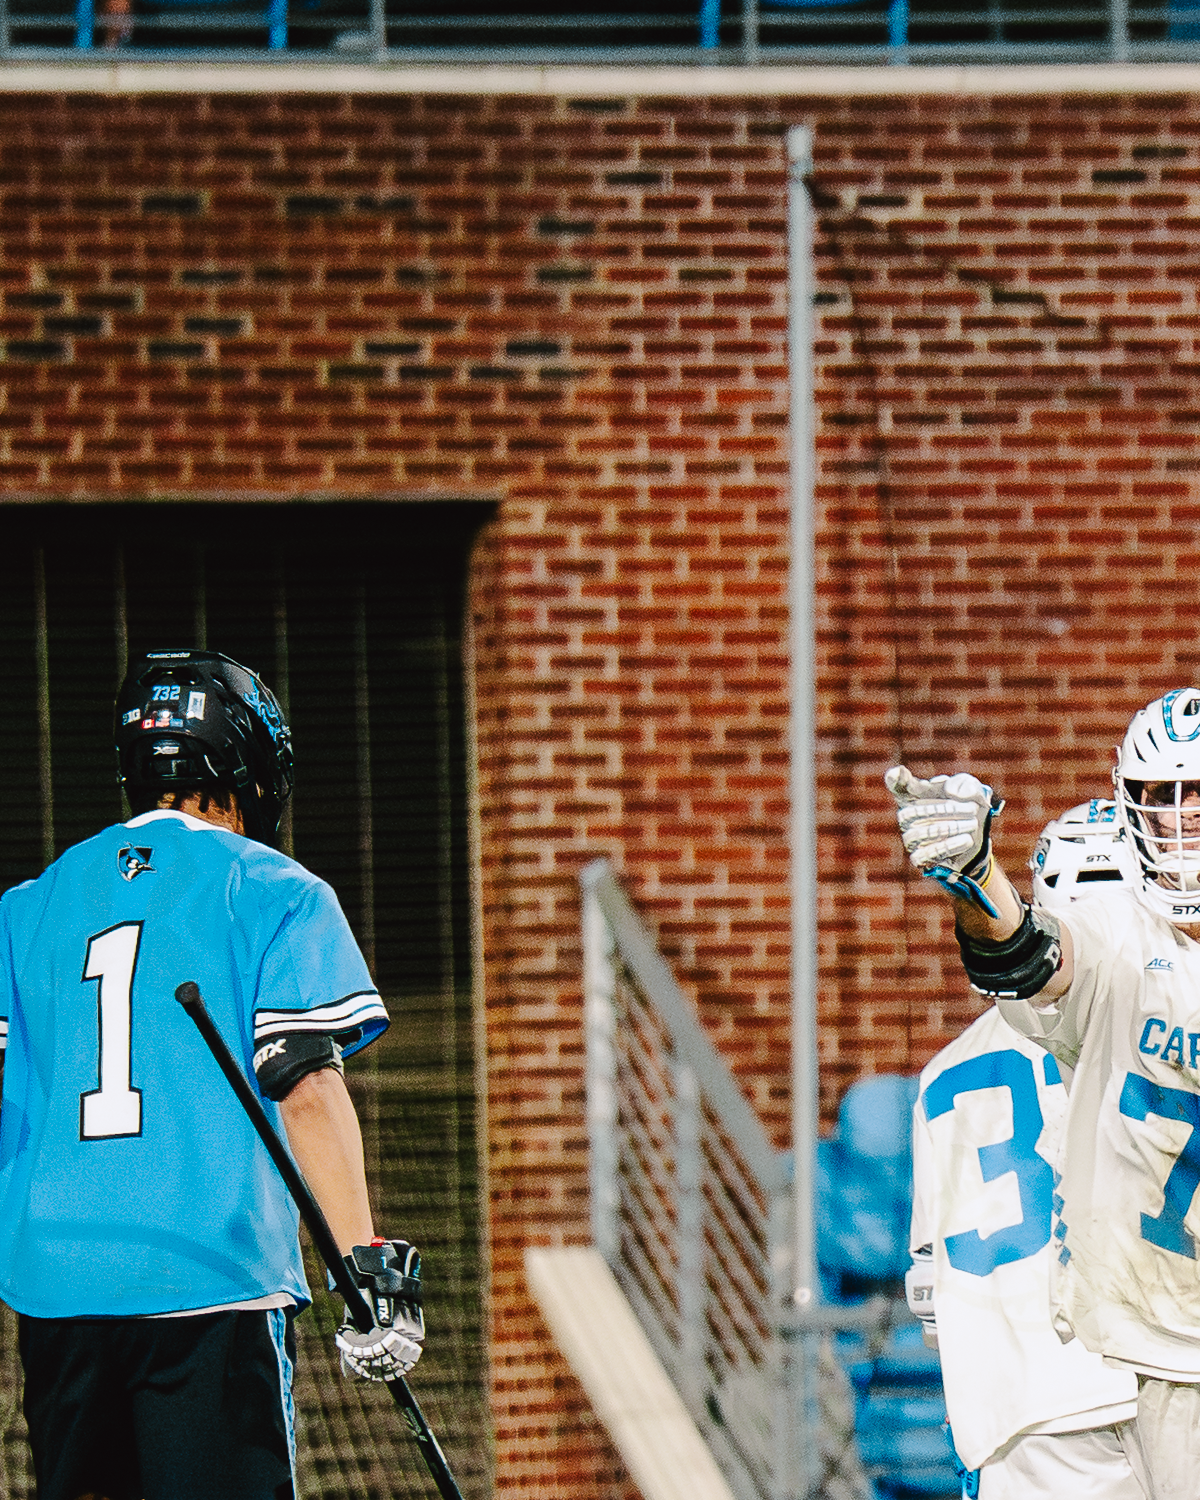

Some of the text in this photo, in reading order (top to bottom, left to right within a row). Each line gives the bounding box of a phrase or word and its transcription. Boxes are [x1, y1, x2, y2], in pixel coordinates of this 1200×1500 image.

[152, 685, 181, 700] 732
[1146, 958, 1175, 969] ACC
[80, 920, 145, 1141] 1
[921, 1049, 1063, 1277] 3
